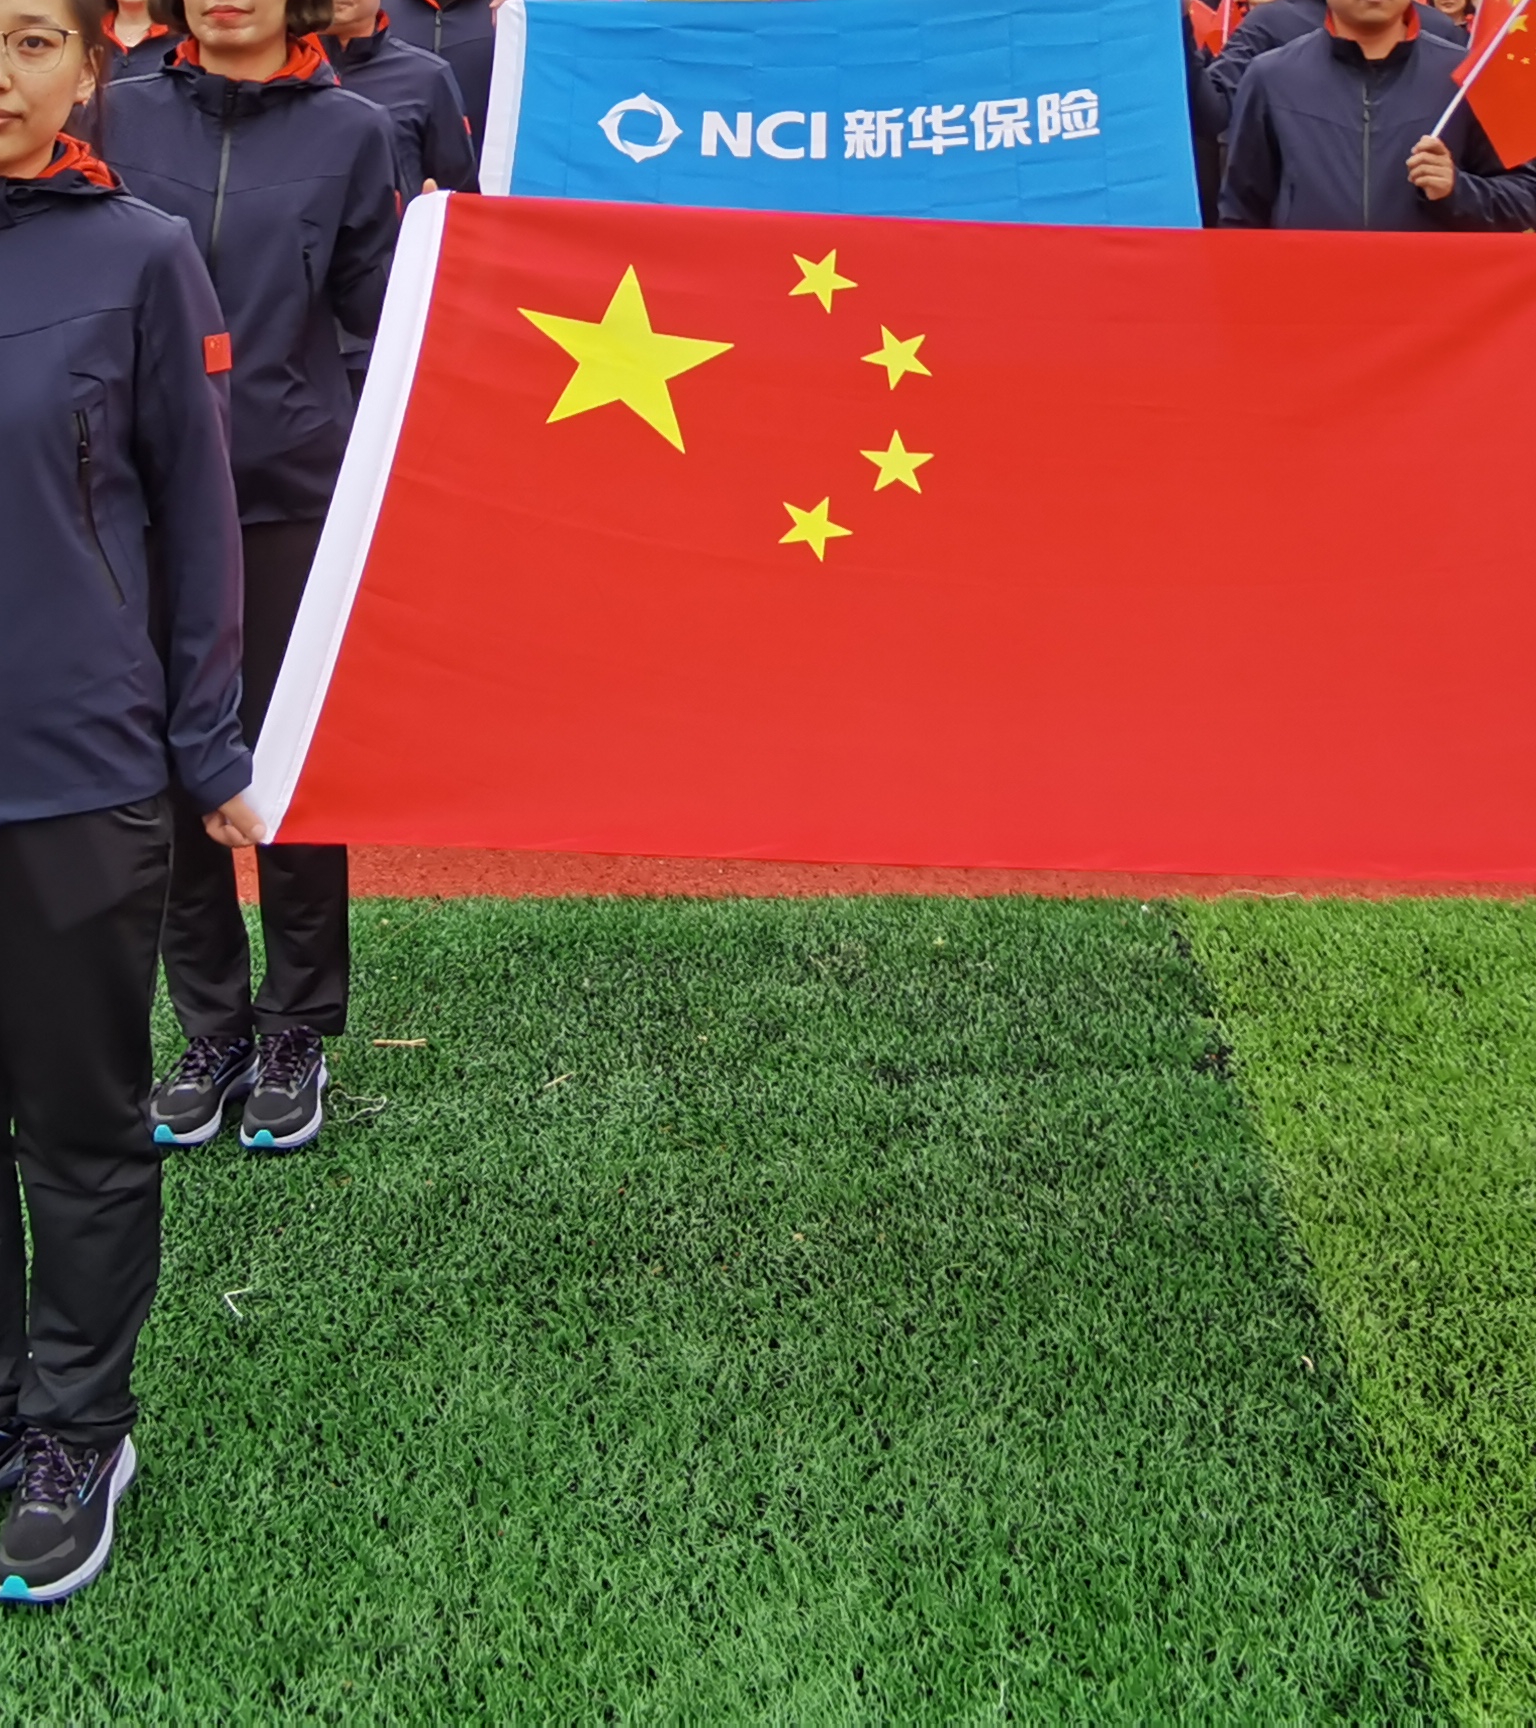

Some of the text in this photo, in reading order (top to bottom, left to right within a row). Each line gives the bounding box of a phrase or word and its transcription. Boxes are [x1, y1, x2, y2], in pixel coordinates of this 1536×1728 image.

[700, 88, 1101, 159] NCI 新华保险
